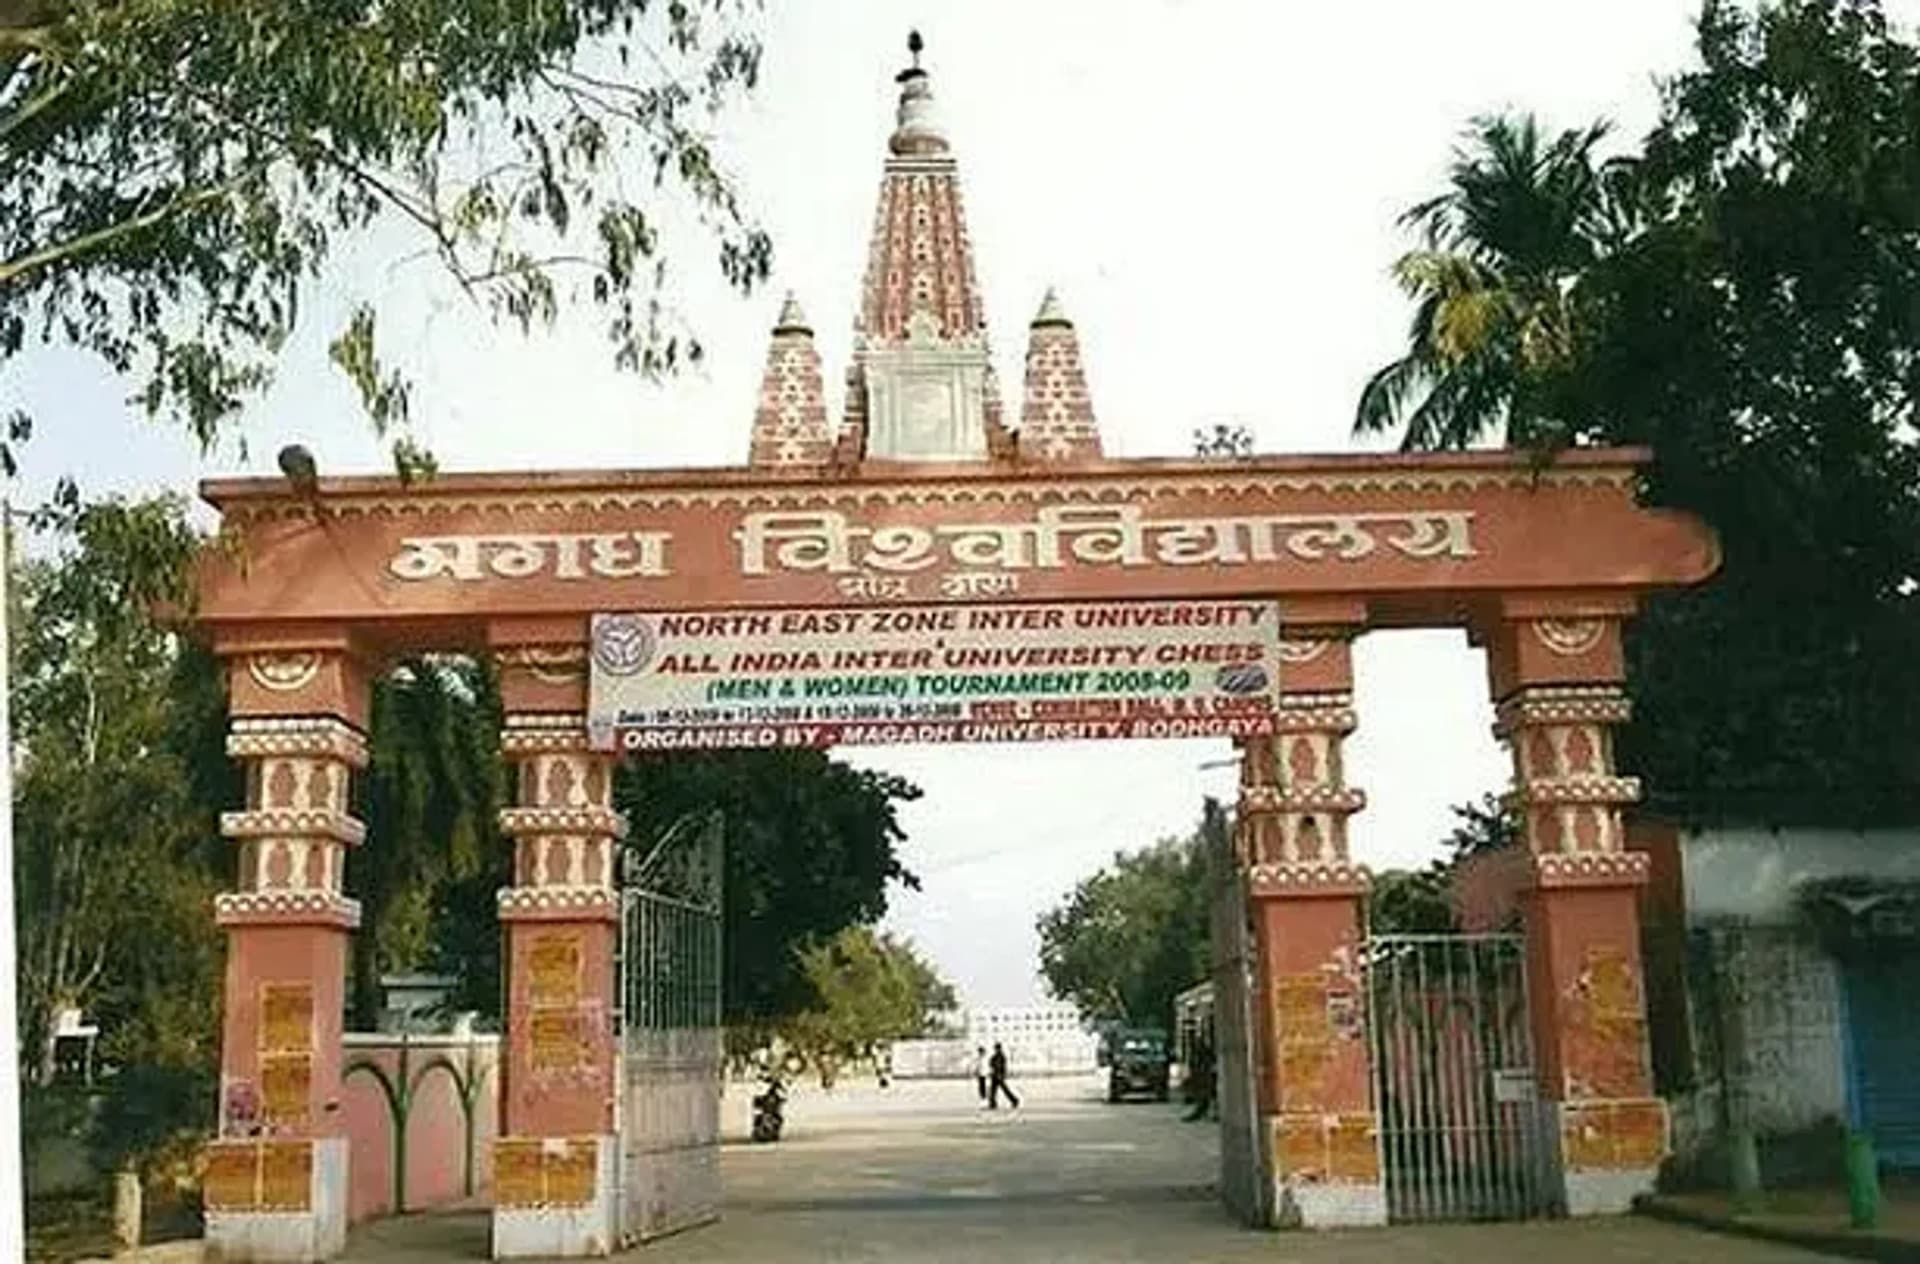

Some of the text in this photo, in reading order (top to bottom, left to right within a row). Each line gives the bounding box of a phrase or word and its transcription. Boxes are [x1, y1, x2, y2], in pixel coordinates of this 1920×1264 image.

[390, 504, 1478, 580] मगध विश्वविद्यालय
[659, 605, 1266, 637] NORTH EAST ZONE INTER UNIVERSITY
[656, 643, 1265, 674] ALL INDIA INTER UNIVERSITY CHESS
[707, 678, 772, 701] (MEN
[779, 678, 796, 697] &
[804, 675, 908, 700] WOMEN)
[917, 671, 1091, 696] TOURNAMENT
[623, 729, 777, 749] ORGANISED
[783, 725, 820, 746] BY
[840, 724, 955, 746] MAGADH
